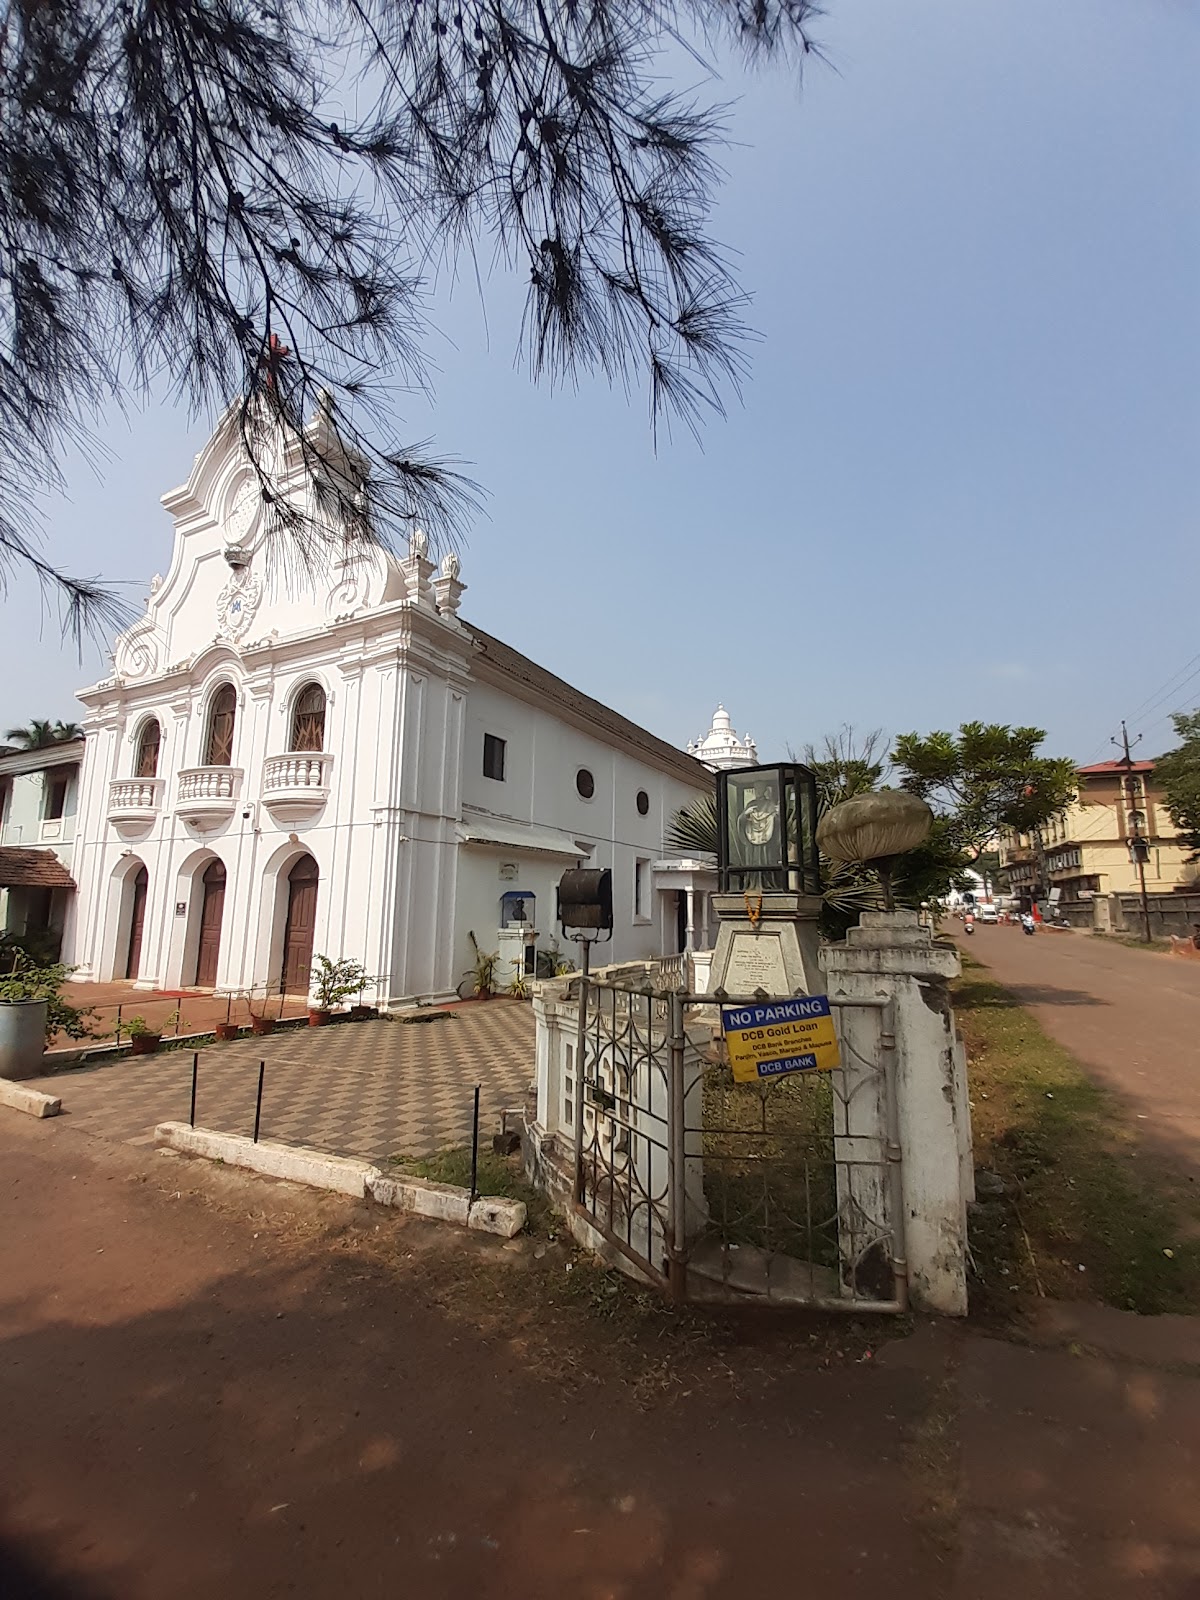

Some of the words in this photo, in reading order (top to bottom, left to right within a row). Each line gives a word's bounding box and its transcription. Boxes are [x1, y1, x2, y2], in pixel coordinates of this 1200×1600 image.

[729, 1012, 752, 1026] NO
[755, 1000, 823, 1022] PARKING
[741, 1030, 764, 1042] DCB
[767, 1026, 791, 1038] Gold
[793, 1022, 819, 1033] Loan
[752, 1042, 766, 1051] DCB
[767, 1041, 783, 1049] Bank
[783, 1036, 812, 1047] Branches
[735, 1053, 757, 1062] Panjim,
[760, 1060, 783, 1074] DCB
[785, 1056, 814, 1070] BANK
